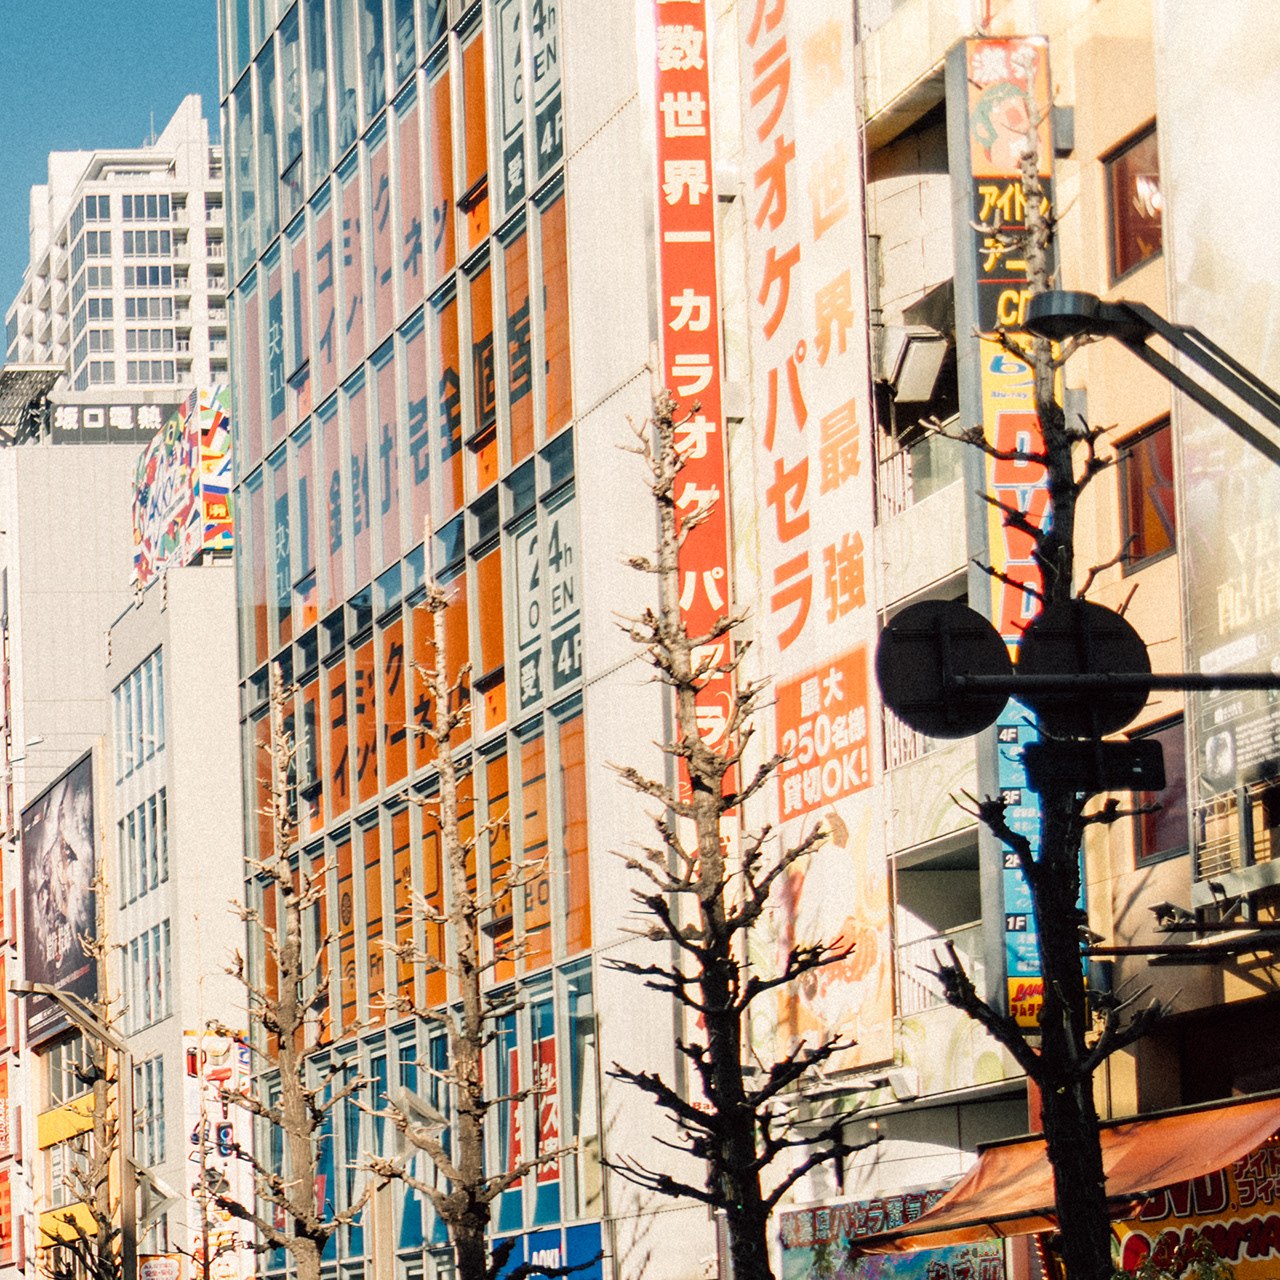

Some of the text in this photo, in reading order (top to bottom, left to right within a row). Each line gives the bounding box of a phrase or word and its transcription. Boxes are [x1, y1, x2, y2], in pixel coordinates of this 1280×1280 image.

[512, 38, 559, 106] OEN
[54, 405, 163, 430] 坂口電熱
[528, 576, 575, 629] OEN
[801, 667, 843, 719] 最大
[781, 704, 867, 774] 250名様
[998, 727, 1017, 742] 4F
[782, 746, 869, 817] 貸切OK!
[1002, 789, 1021, 804] 3F
[1006, 915, 1026, 931] 1F
